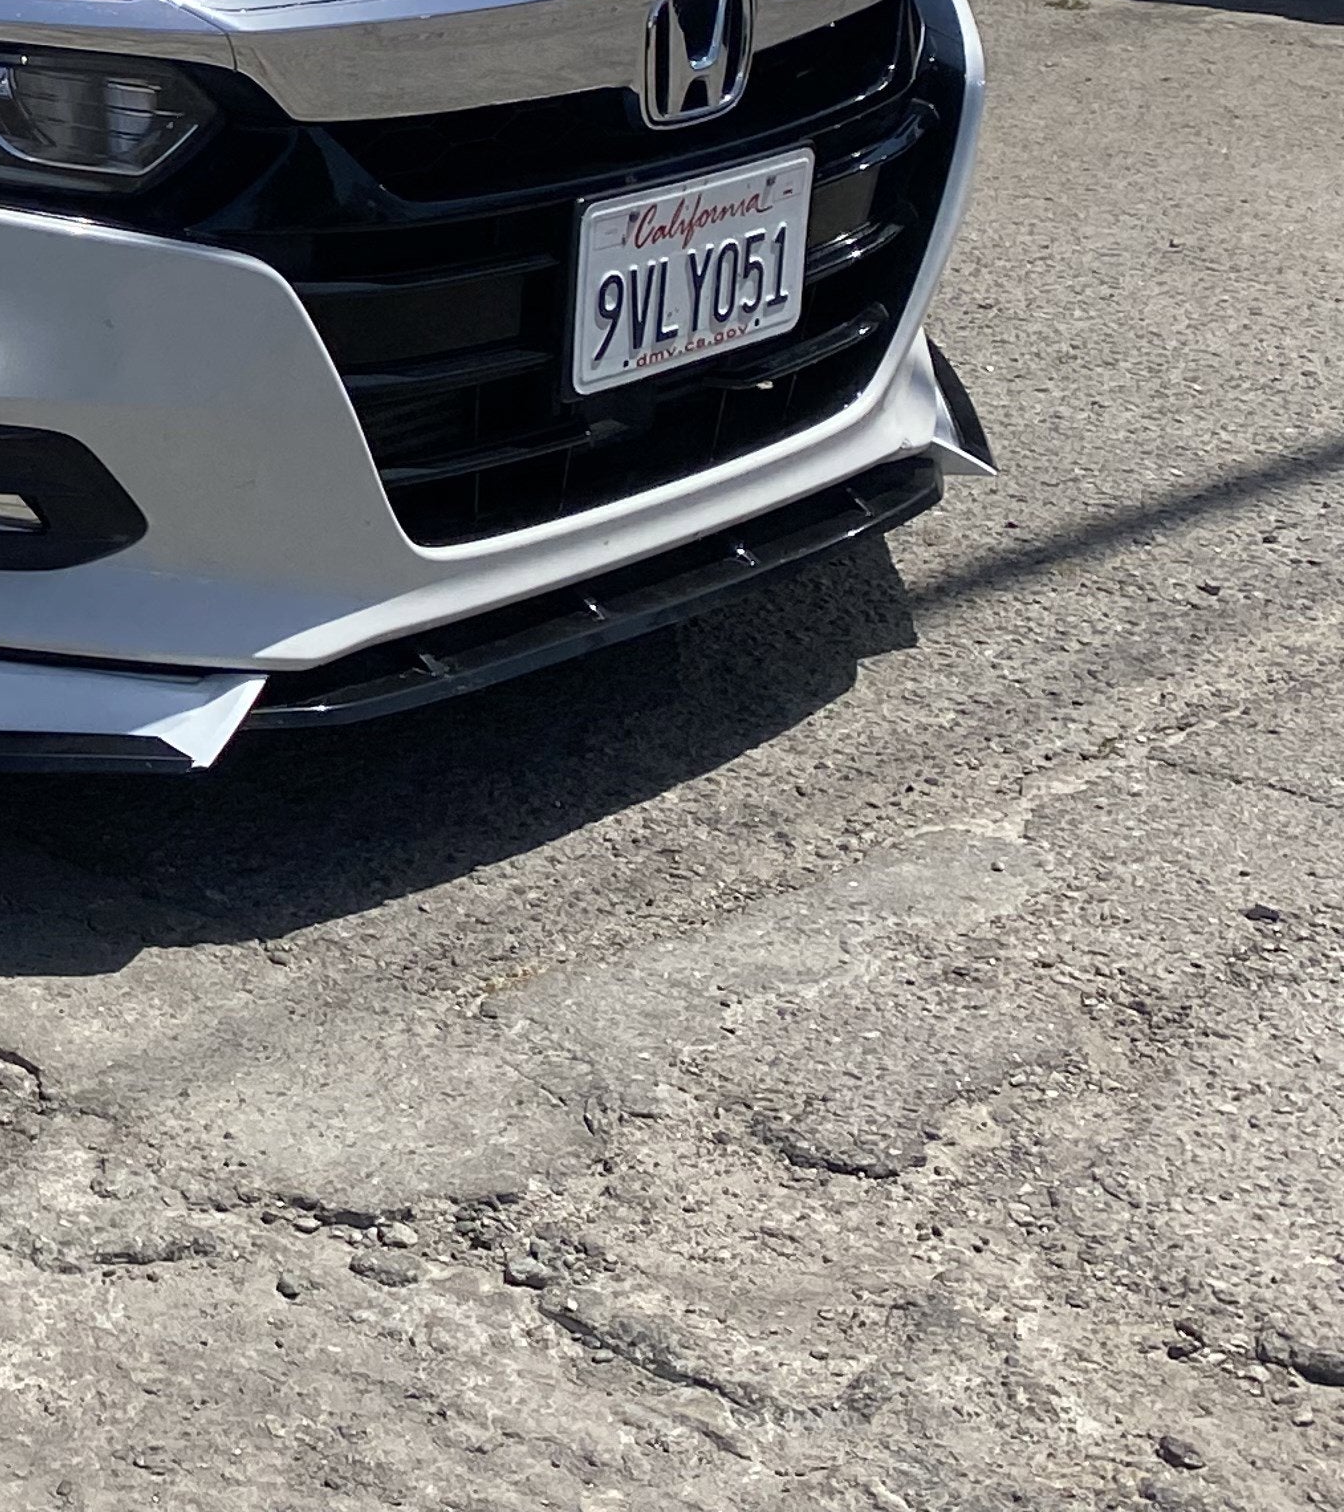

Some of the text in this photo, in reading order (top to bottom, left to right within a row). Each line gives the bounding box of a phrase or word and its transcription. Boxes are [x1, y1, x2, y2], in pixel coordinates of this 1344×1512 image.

[634, 192, 773, 250] California
[592, 222, 789, 362] 9VLY051
[635, 323, 749, 368] dmv.ca.gov
